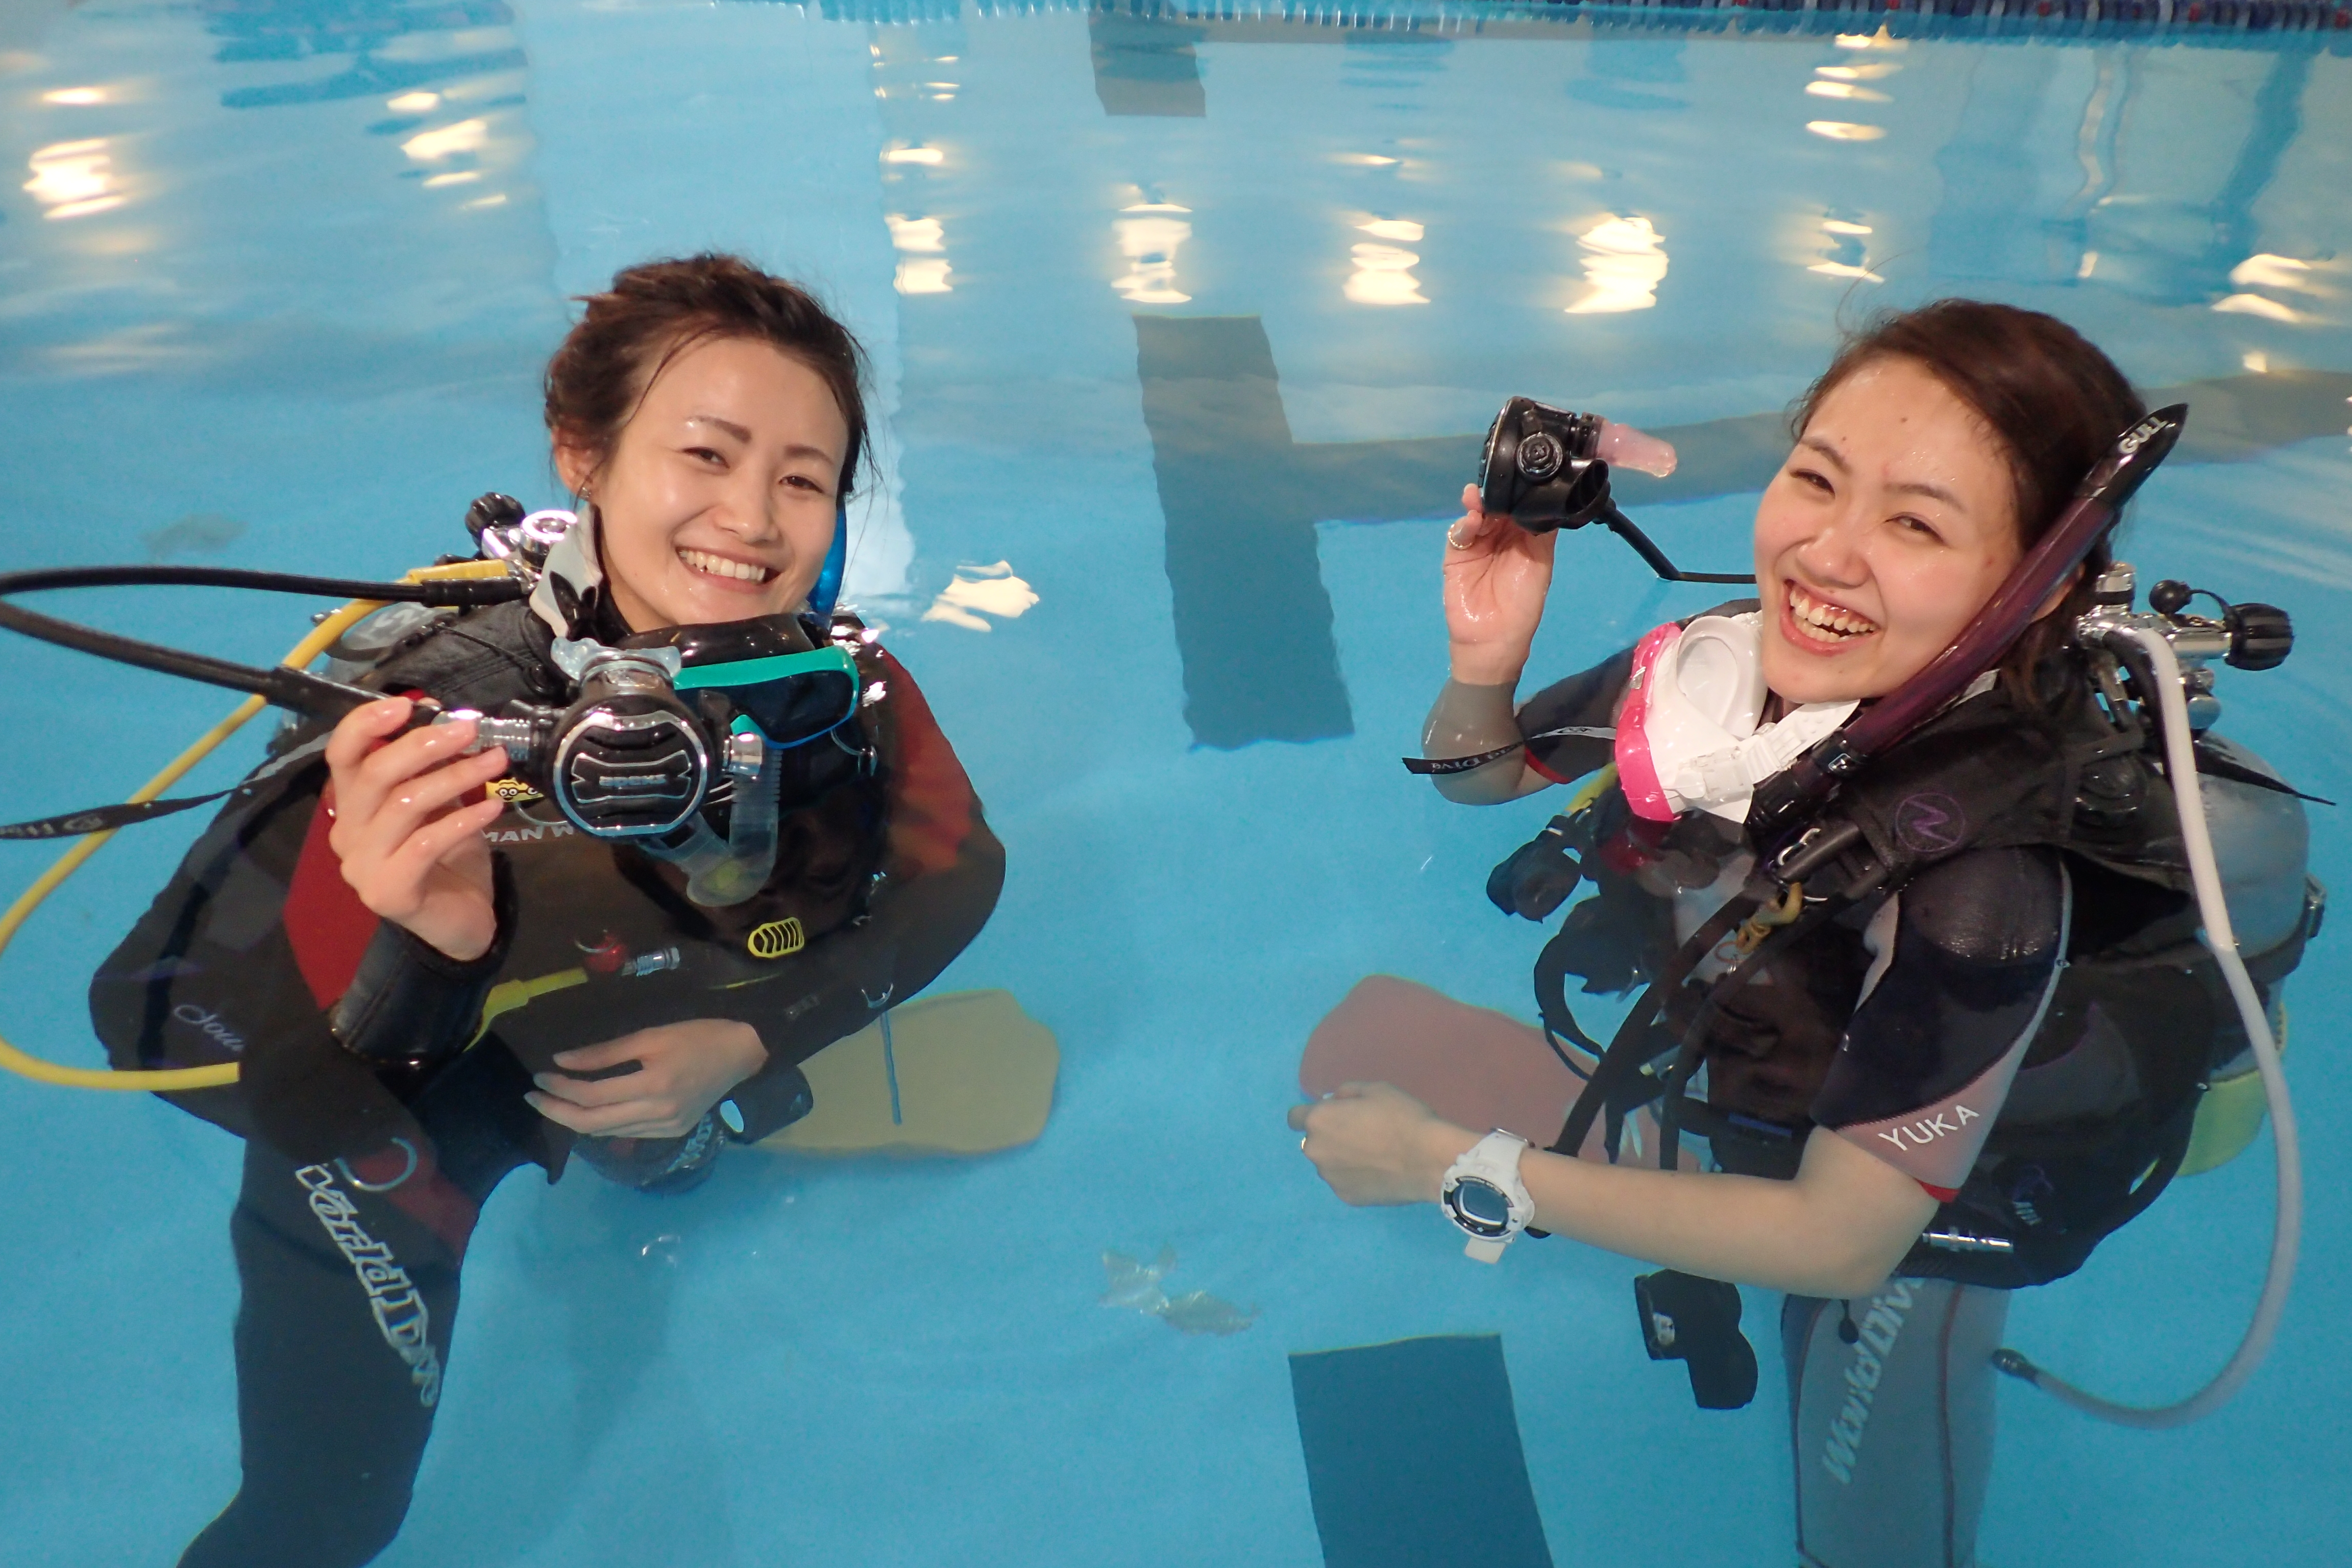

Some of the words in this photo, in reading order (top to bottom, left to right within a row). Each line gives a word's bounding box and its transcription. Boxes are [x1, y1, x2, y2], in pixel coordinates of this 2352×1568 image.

[2118, 416, 2169, 454] GULL
[1877, 1104, 1980, 1152] YUKA
[1822, 1341, 1882, 1485] World
